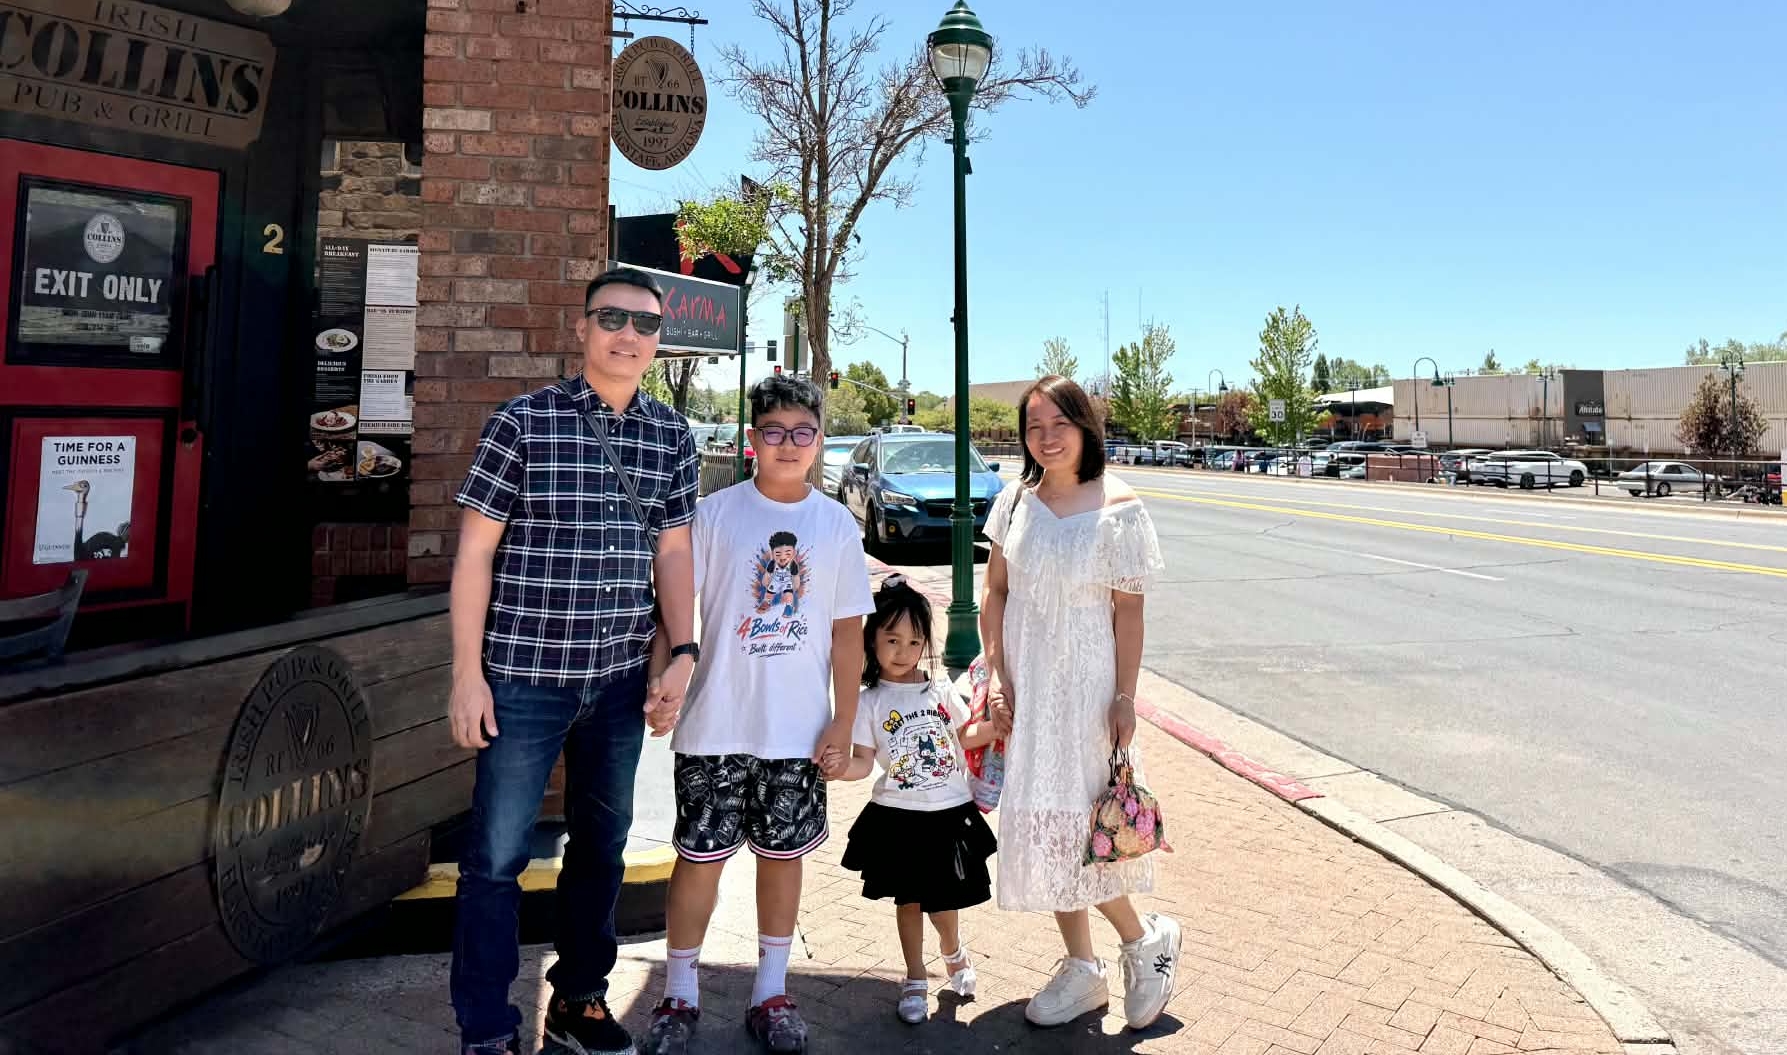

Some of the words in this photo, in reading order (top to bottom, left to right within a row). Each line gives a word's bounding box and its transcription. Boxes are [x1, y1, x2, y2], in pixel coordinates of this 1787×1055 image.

[93, 0, 200, 42] IRISH
[0, 10, 264, 114] COLLINS
[14, 82, 81, 113] PUB
[94, 99, 114, 120] &
[129, 103, 218, 137] GRILL
[612, 89, 705, 115] COLLINS
[87, 232, 122, 243] COLLINS
[263, 223, 284, 255] 2
[34, 268, 93, 298] EXIT
[103, 274, 162, 304] ONLY
[1271, 411, 1283, 419] 30
[54, 442, 83, 452] TIME
[88, 442, 113, 452] FOR
[117, 442, 125, 452] A
[57, 455, 121, 466] GUINNESS
[736, 617, 752, 641] 4
[749, 617, 780, 638] Bowls
[787, 620, 808, 641] Rice
[222, 758, 370, 848] COLLINS
